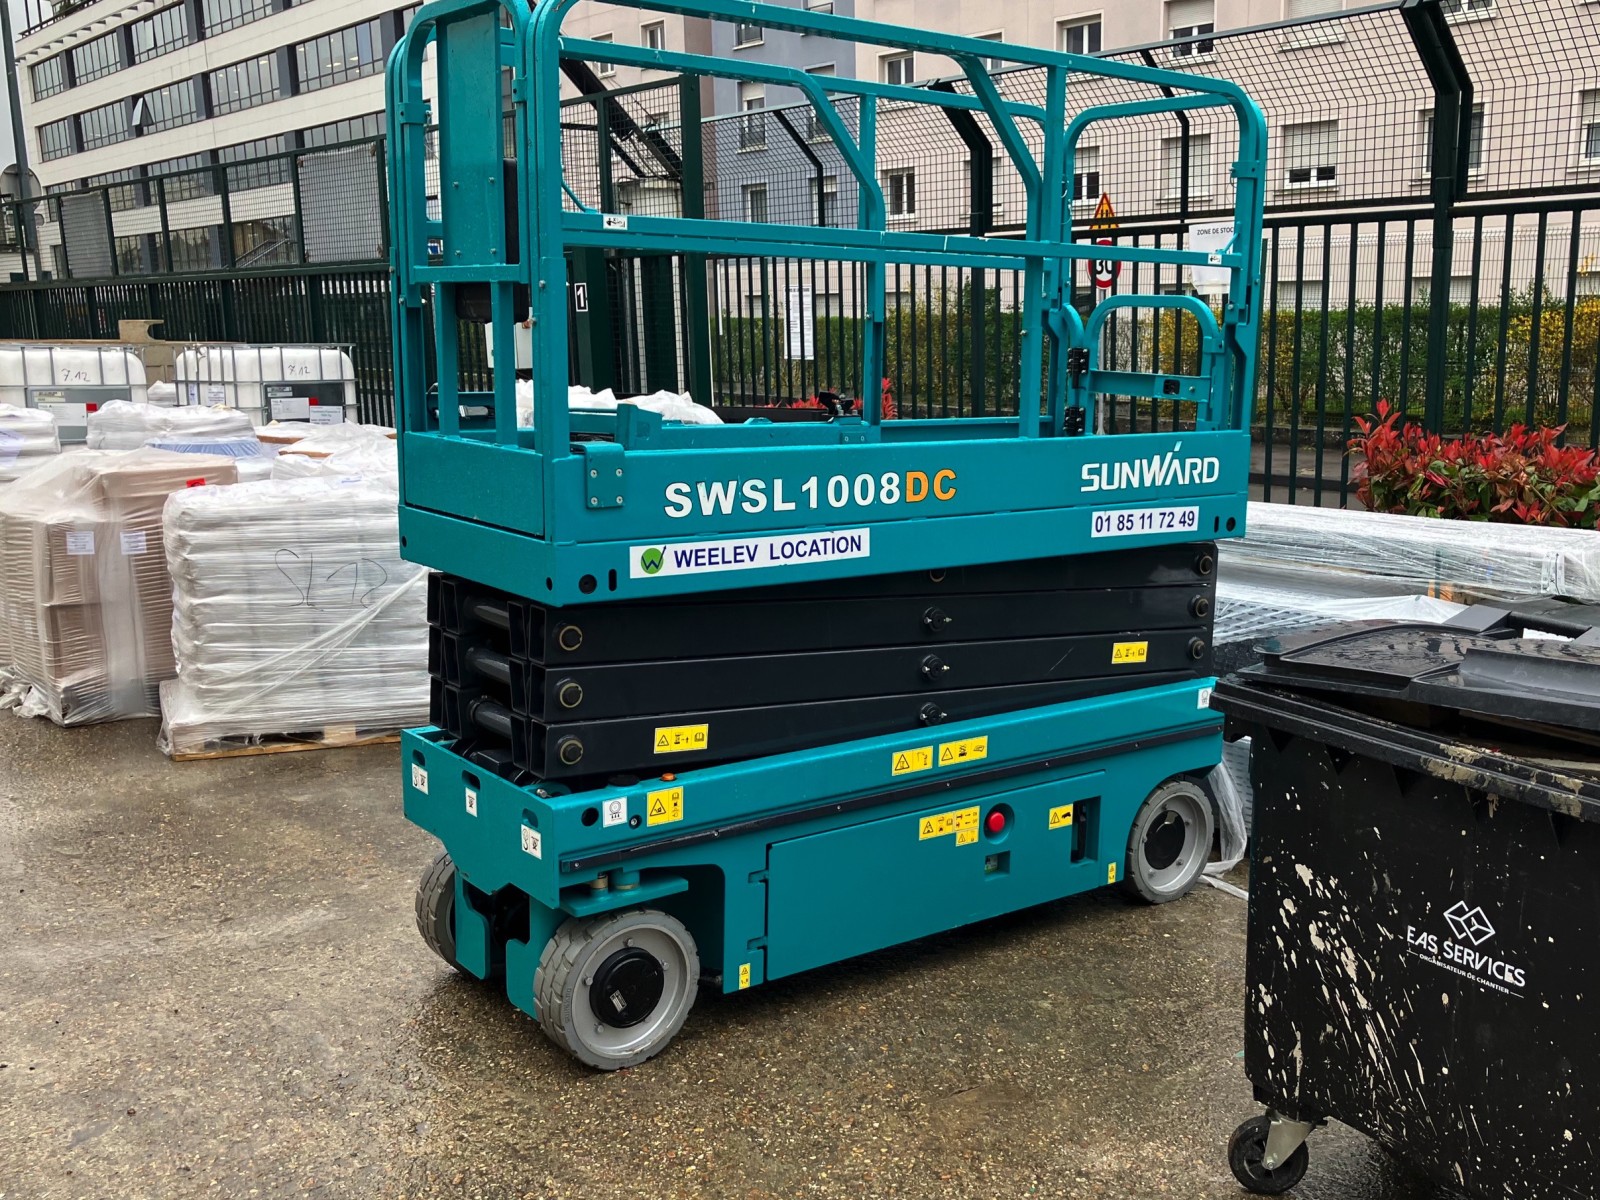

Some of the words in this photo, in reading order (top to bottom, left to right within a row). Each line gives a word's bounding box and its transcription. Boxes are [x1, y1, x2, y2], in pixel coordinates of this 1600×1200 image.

[577, 286, 585, 307] 1
[1080, 441, 1220, 492] SUNWARD
[1095, 515, 1111, 533] 01
[1117, 514, 1134, 531] 85
[1139, 513, 1153, 529] 11
[1159, 512, 1174, 528] 72
[1179, 511, 1195, 527] 49
[674, 544, 759, 568] WEELEV
[769, 535, 862, 560] LOCATION
[1407, 925, 1438, 953] EAS
[1443, 941, 1526, 988] SERVICES
[1419, 954, 1466, 977] ORGANISATEUR
[1476, 977, 1510, 995] CHANTIER
